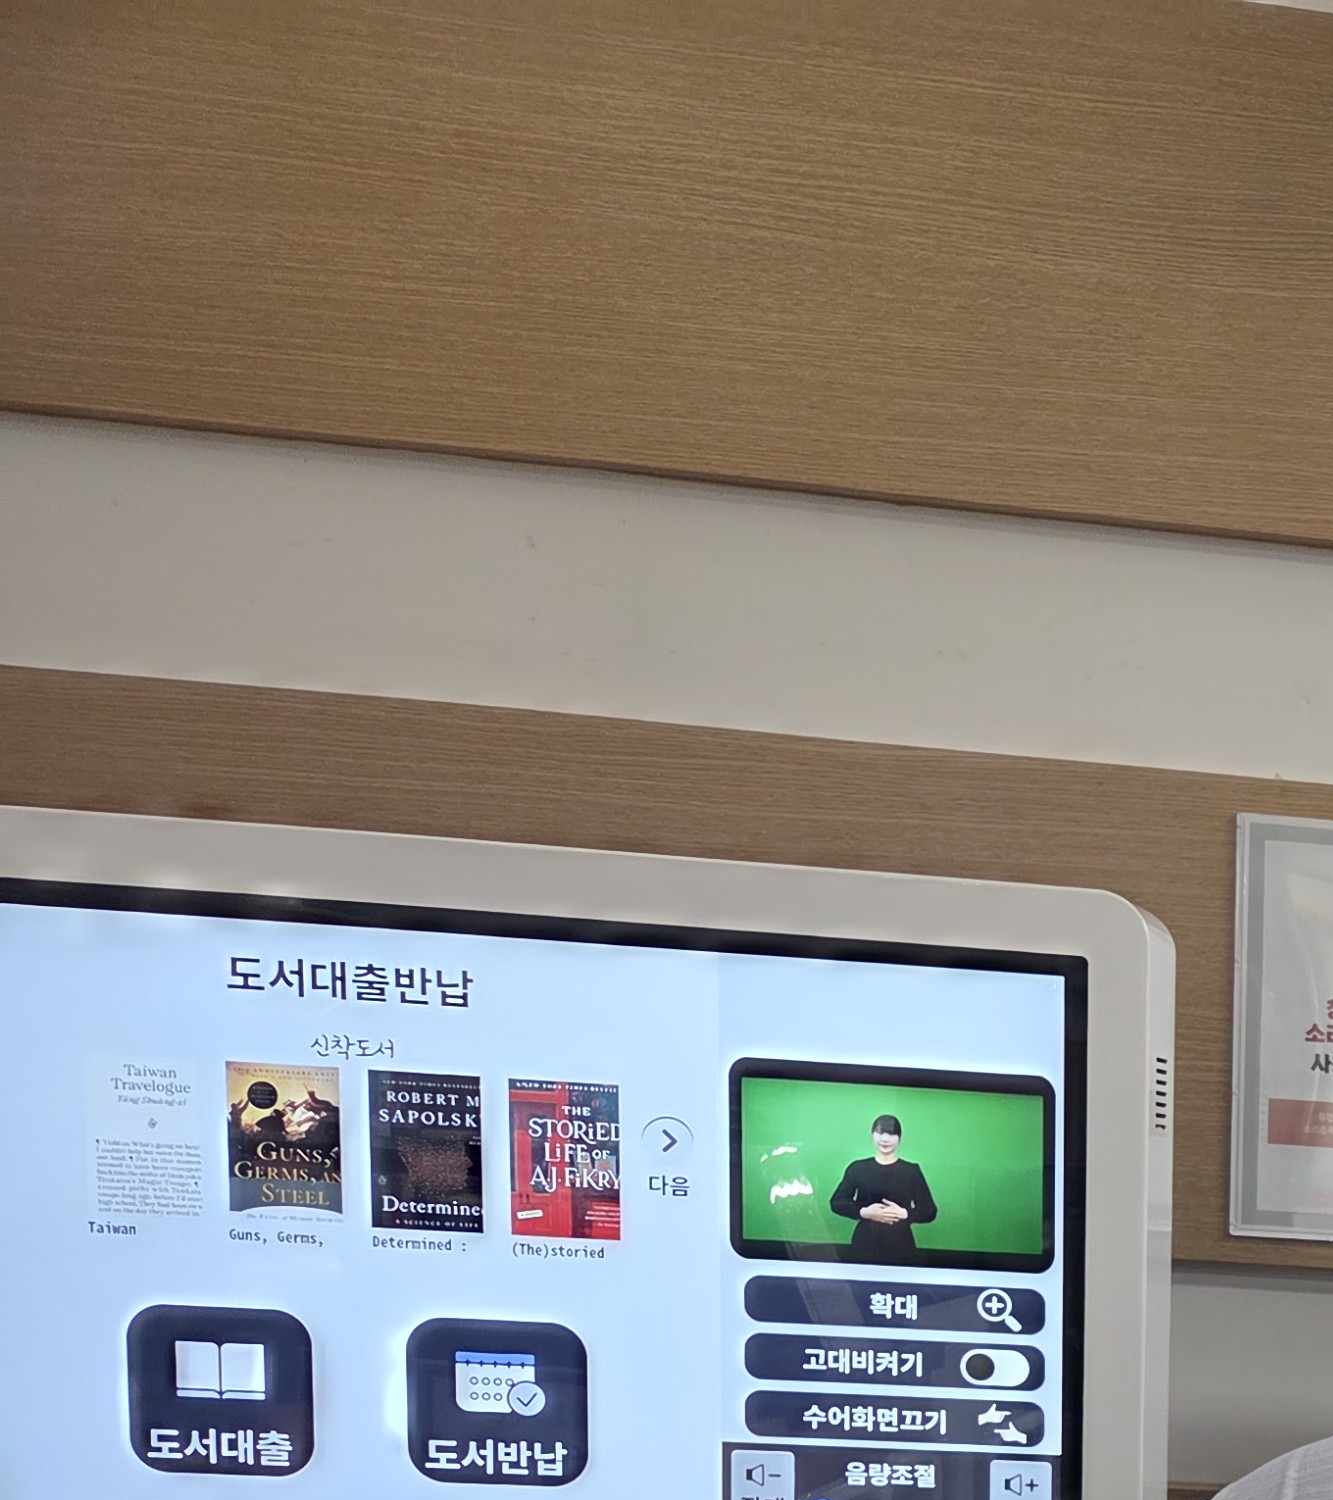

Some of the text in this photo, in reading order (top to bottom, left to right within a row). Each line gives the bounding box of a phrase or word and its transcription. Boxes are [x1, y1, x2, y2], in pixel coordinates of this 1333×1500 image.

[226, 956, 474, 1008] 도서대출반납
[310, 1034, 396, 1060] 신착도서
[123, 1063, 177, 1079] Taiwan
[110, 1077, 191, 1095] Travelogue
[387, 1090, 459, 1107] ROBERT
[378, 1109, 481, 1128] SAPOLSK
[562, 1106, 591, 1117] THE
[592, 1149, 610, 1160] OF
[261, 1184, 330, 1205] STEEL
[649, 1175, 690, 1197] 다음
[382, 1194, 484, 1217] Determine
[88, 1222, 136, 1235] Taiwan
[229, 1229, 324, 1246] Guns, Germs,
[372, 1236, 452, 1251] Determined
[512, 1244, 605, 1260] (The)storied
[870, 1293, 918, 1320] 확대
[802, 1349, 923, 1377] 고대비켜기
[802, 1405, 947, 1434] 수어화면끄기
[147, 1427, 568, 1476] 도서대출 도서반납
[845, 1462, 936, 1488] 음량조절
